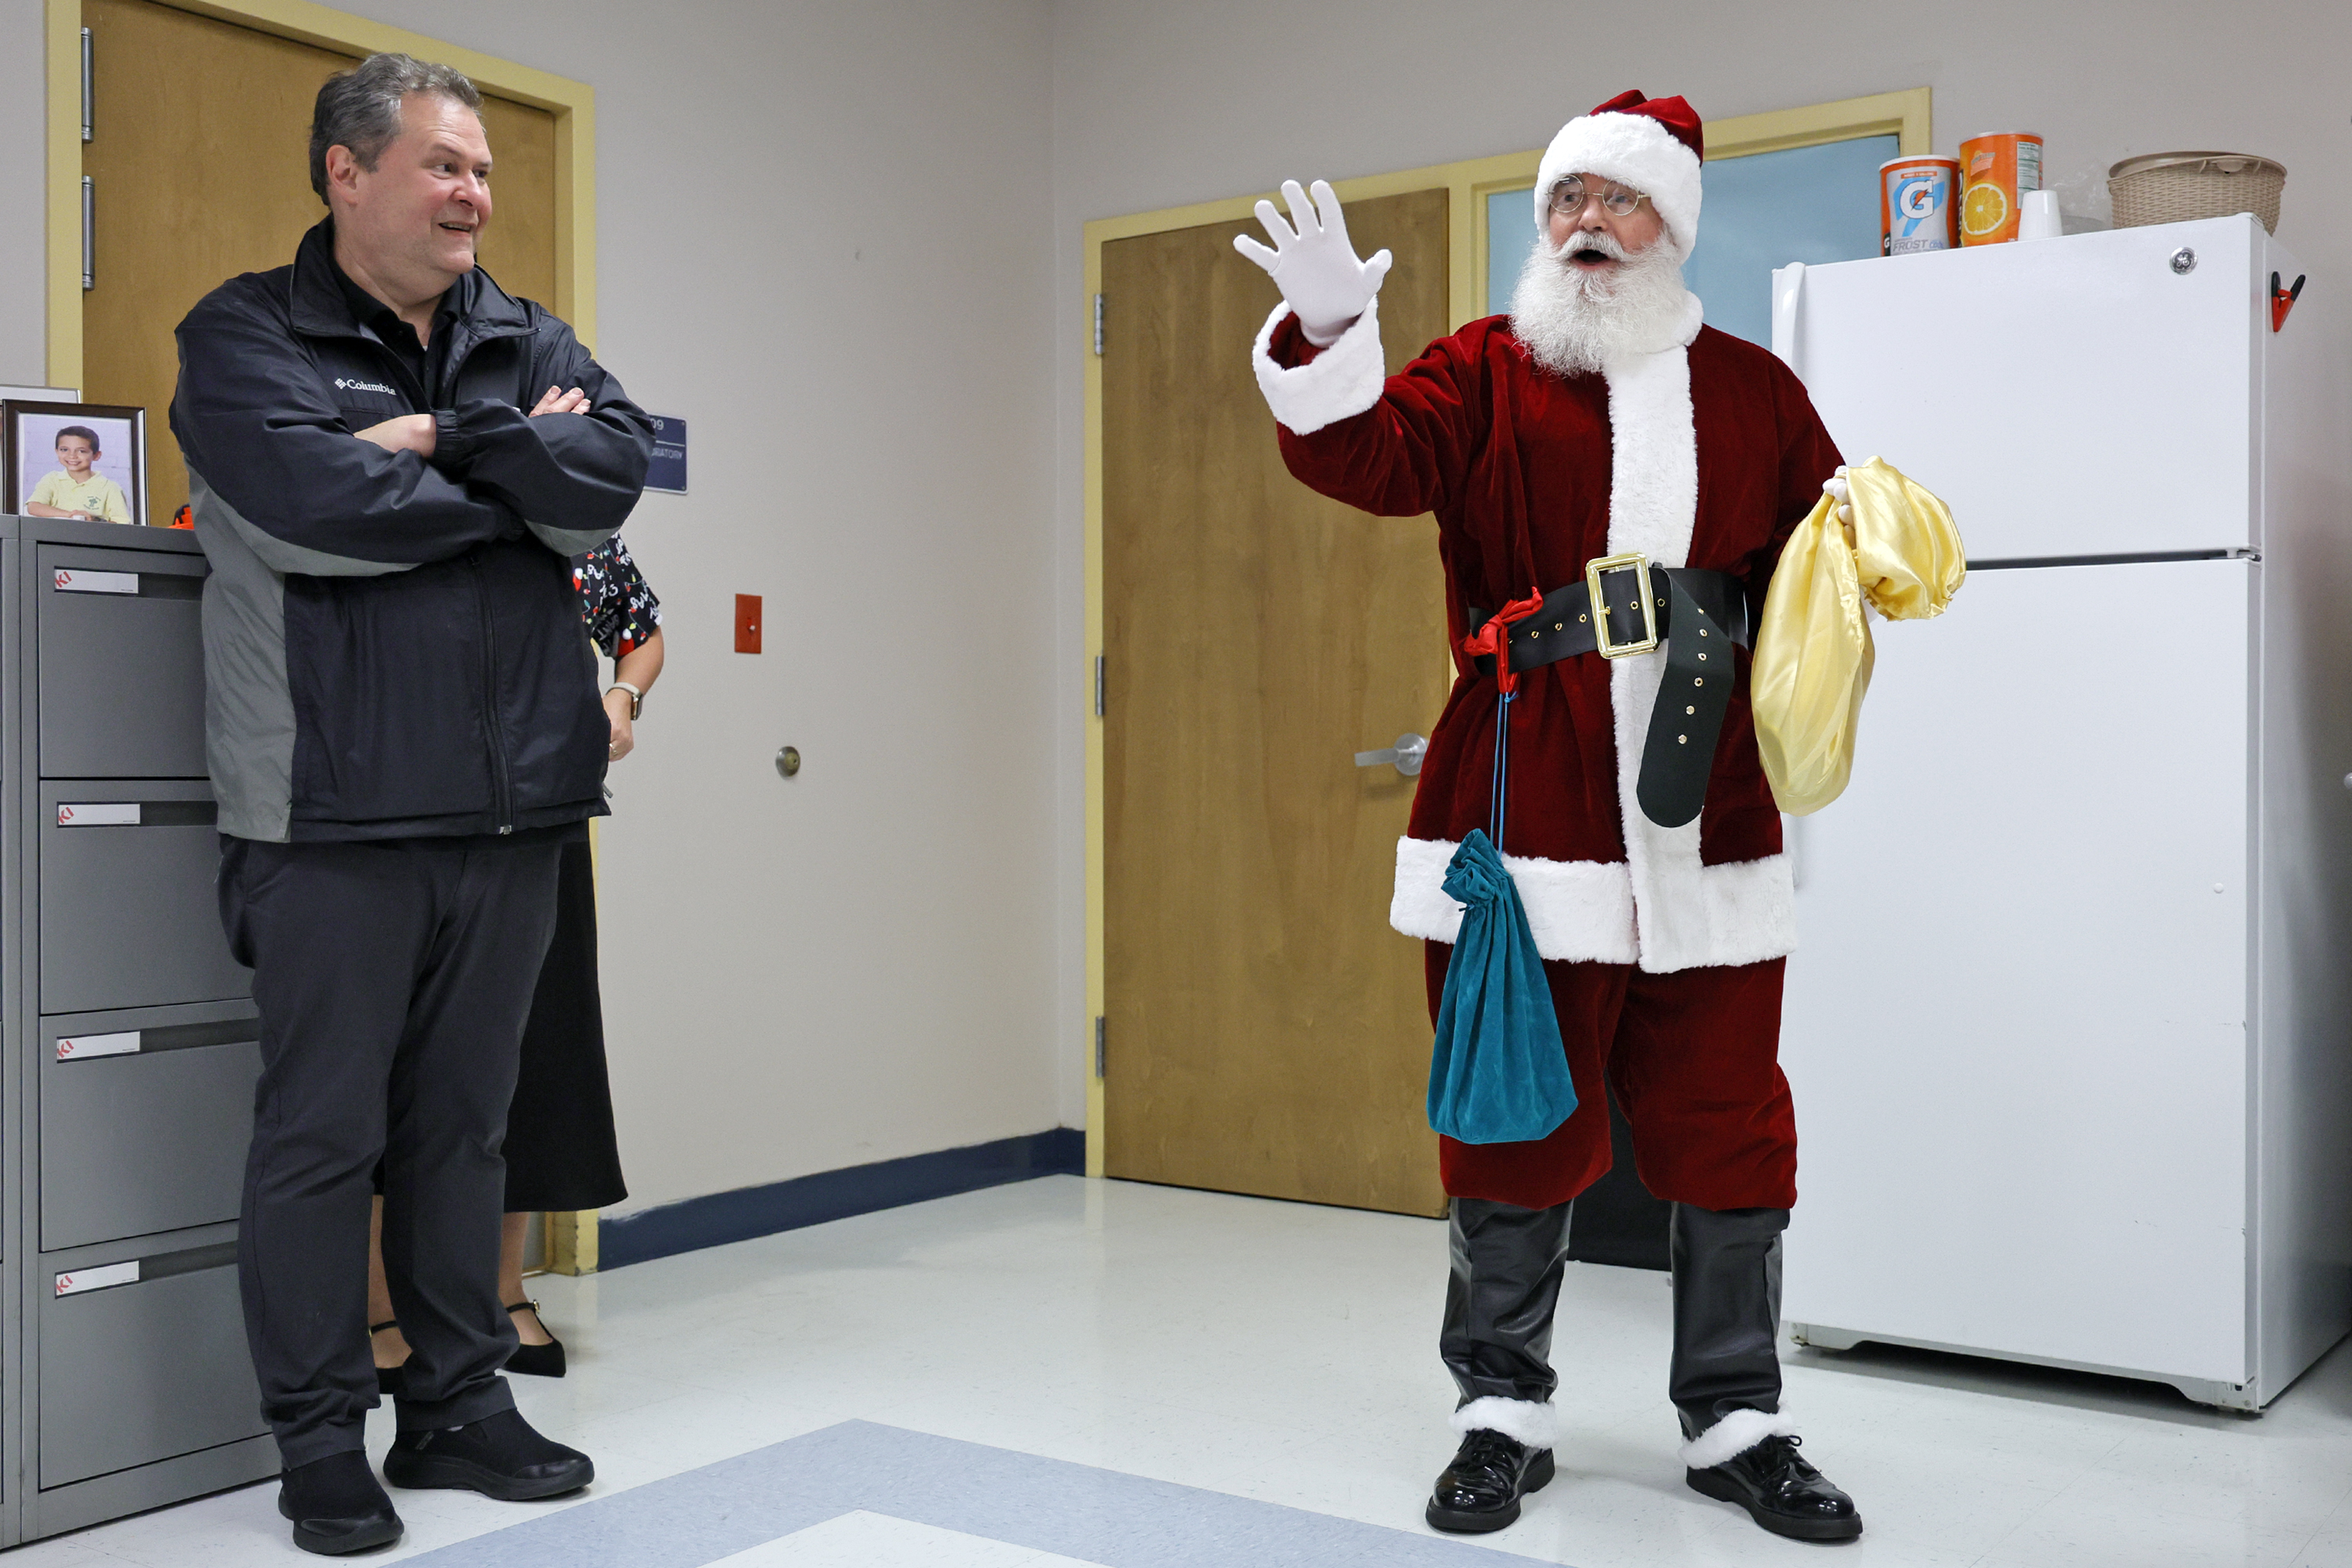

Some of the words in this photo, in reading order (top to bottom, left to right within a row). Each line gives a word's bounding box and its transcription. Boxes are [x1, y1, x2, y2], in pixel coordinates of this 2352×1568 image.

[1899, 179, 1934, 219] G
[1893, 239, 1929, 252] FROST
[347, 379, 397, 396] Columbia
[650, 418, 664, 431] 09
